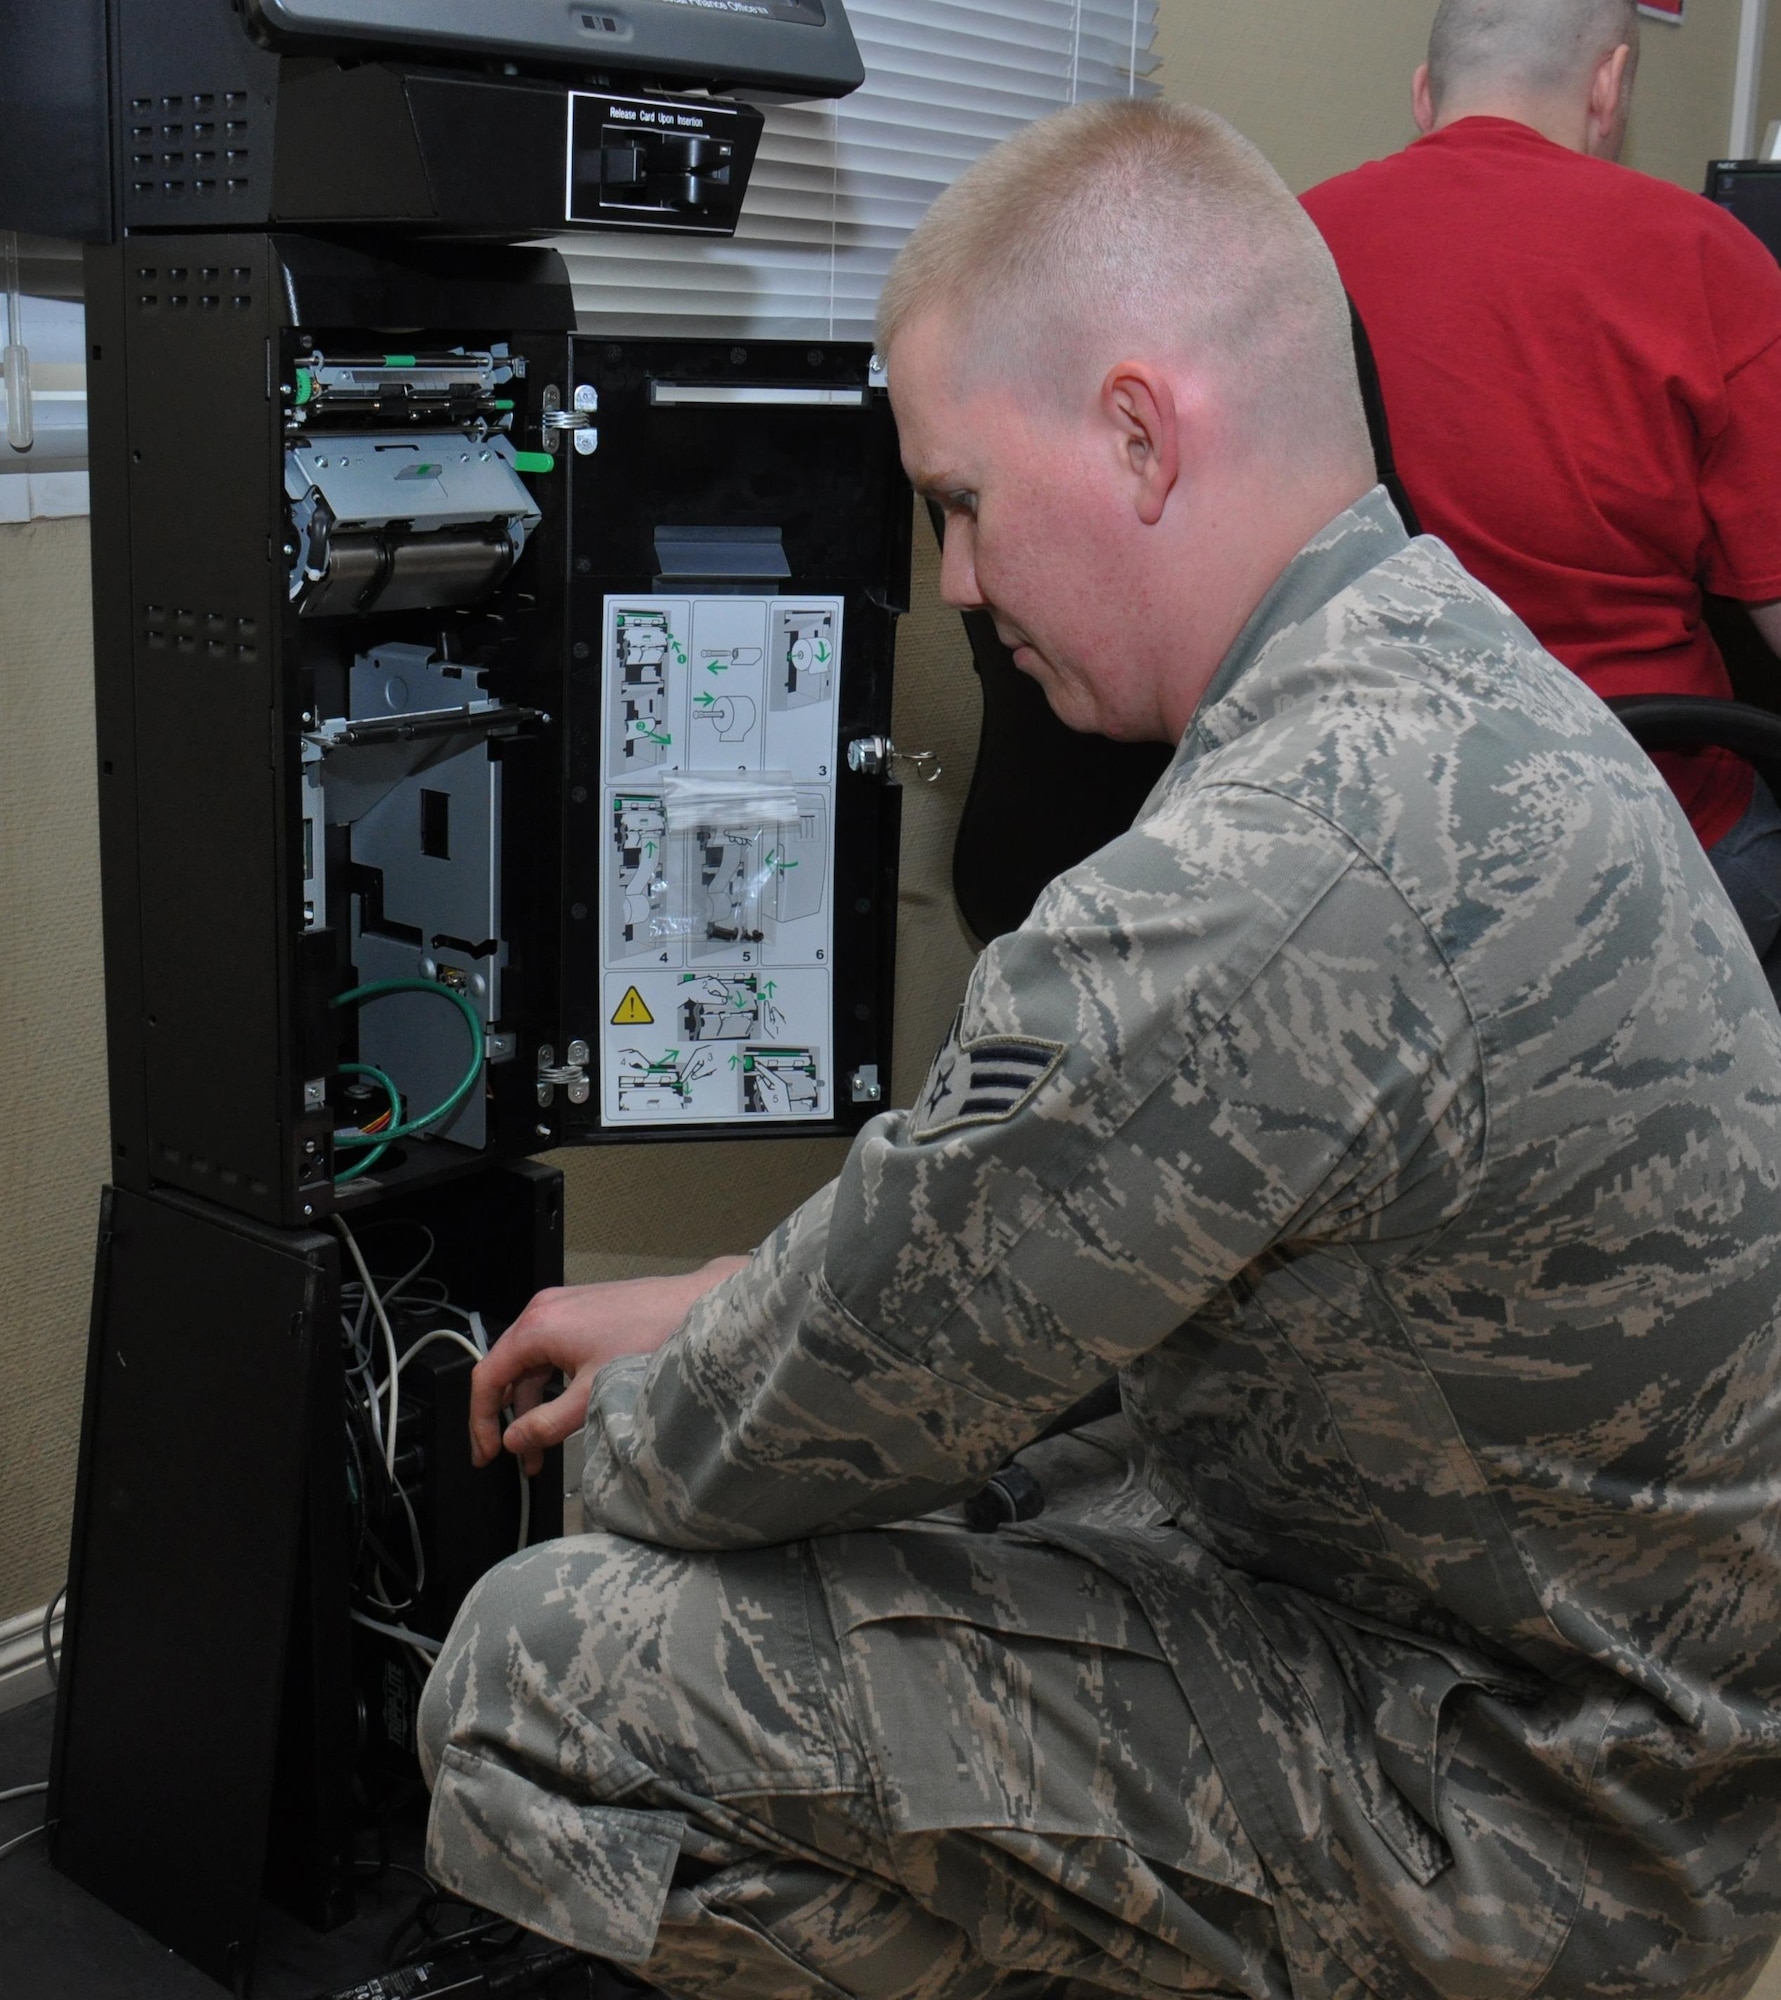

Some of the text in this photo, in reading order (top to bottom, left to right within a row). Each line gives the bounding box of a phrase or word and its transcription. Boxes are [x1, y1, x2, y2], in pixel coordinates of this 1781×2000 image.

[609, 106, 704, 128] Release Card Upon Insertion
[818, 765, 828, 776] 3
[659, 952, 669, 963] 4
[742, 952, 751, 962] 5
[815, 949, 825, 960] 6
[702, 980, 708, 990] 2
[620, 1057, 627, 1066] 4
[707, 1052, 714, 1062] 3
[772, 1094, 779, 1103] 5
